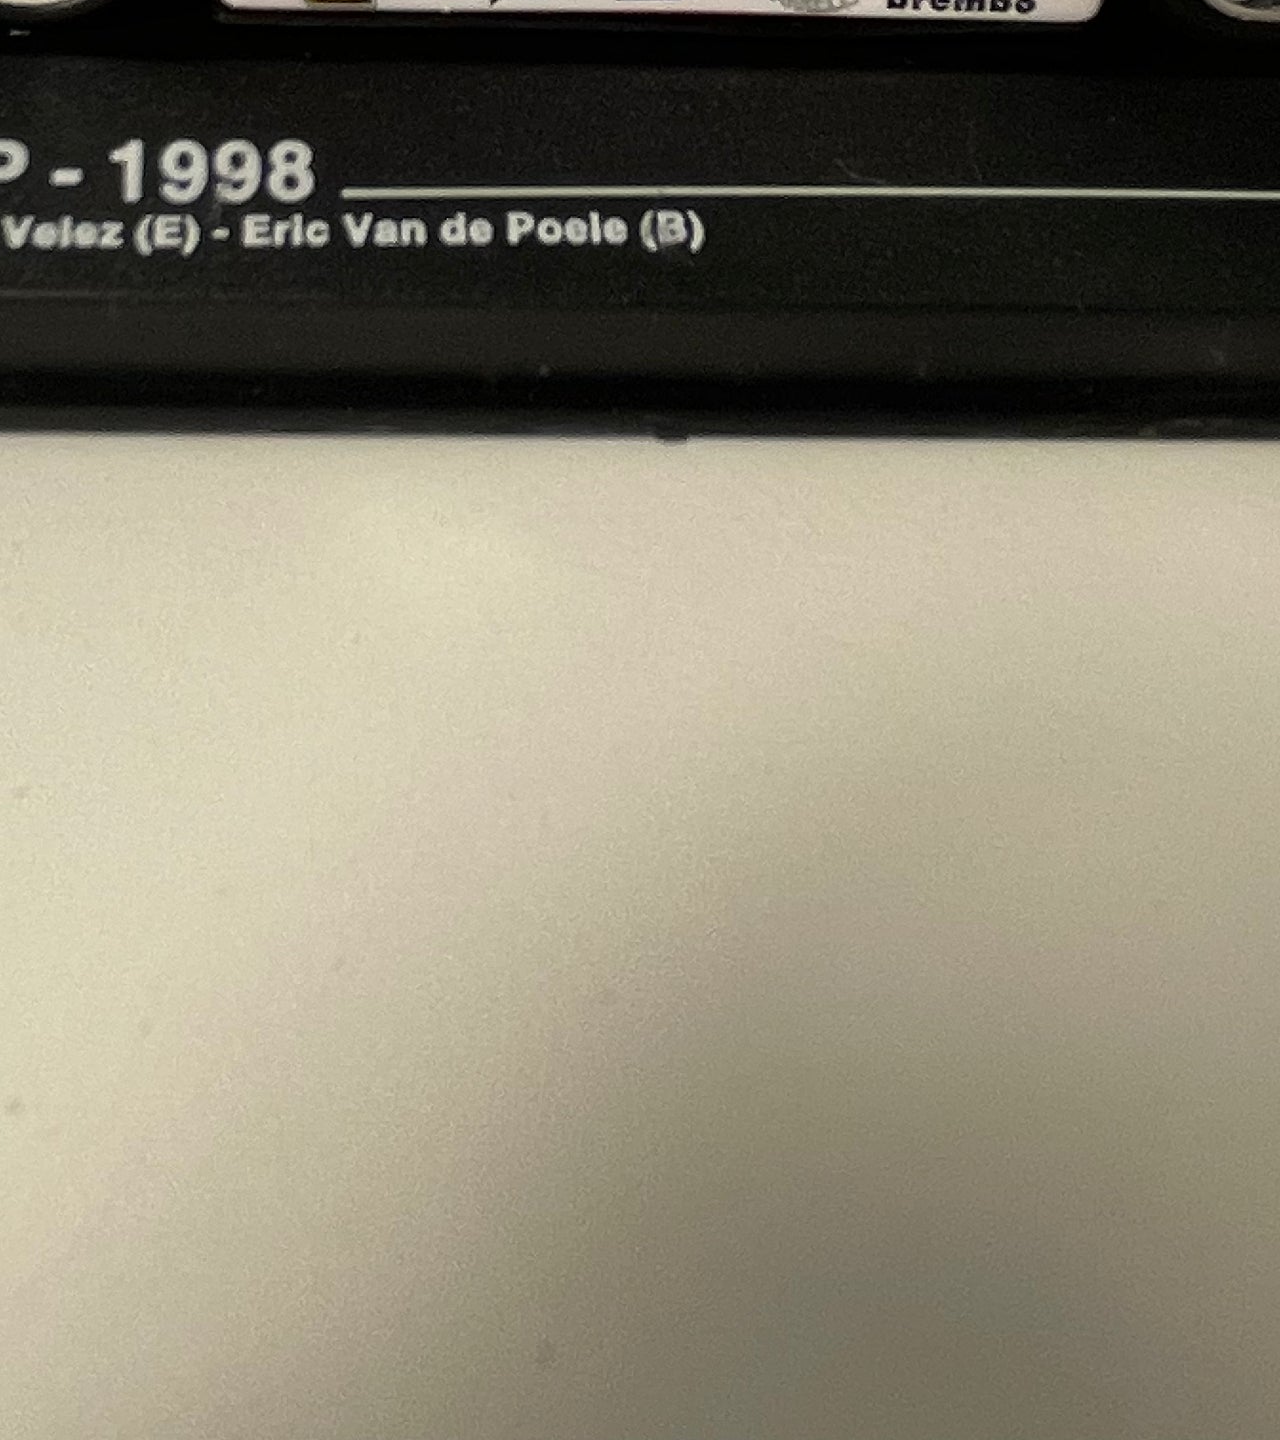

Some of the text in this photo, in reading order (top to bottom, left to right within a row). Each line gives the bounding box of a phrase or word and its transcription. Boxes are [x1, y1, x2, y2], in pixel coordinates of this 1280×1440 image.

[108, 137, 317, 205] 1998
[2, 213, 124, 250] Velez
[134, 213, 201, 258] (E)
[240, 213, 331, 249] Eric
[343, 211, 428, 248] Van
[439, 212, 494, 248] de
[506, 210, 629, 248] Poele
[639, 210, 706, 256] (B)
